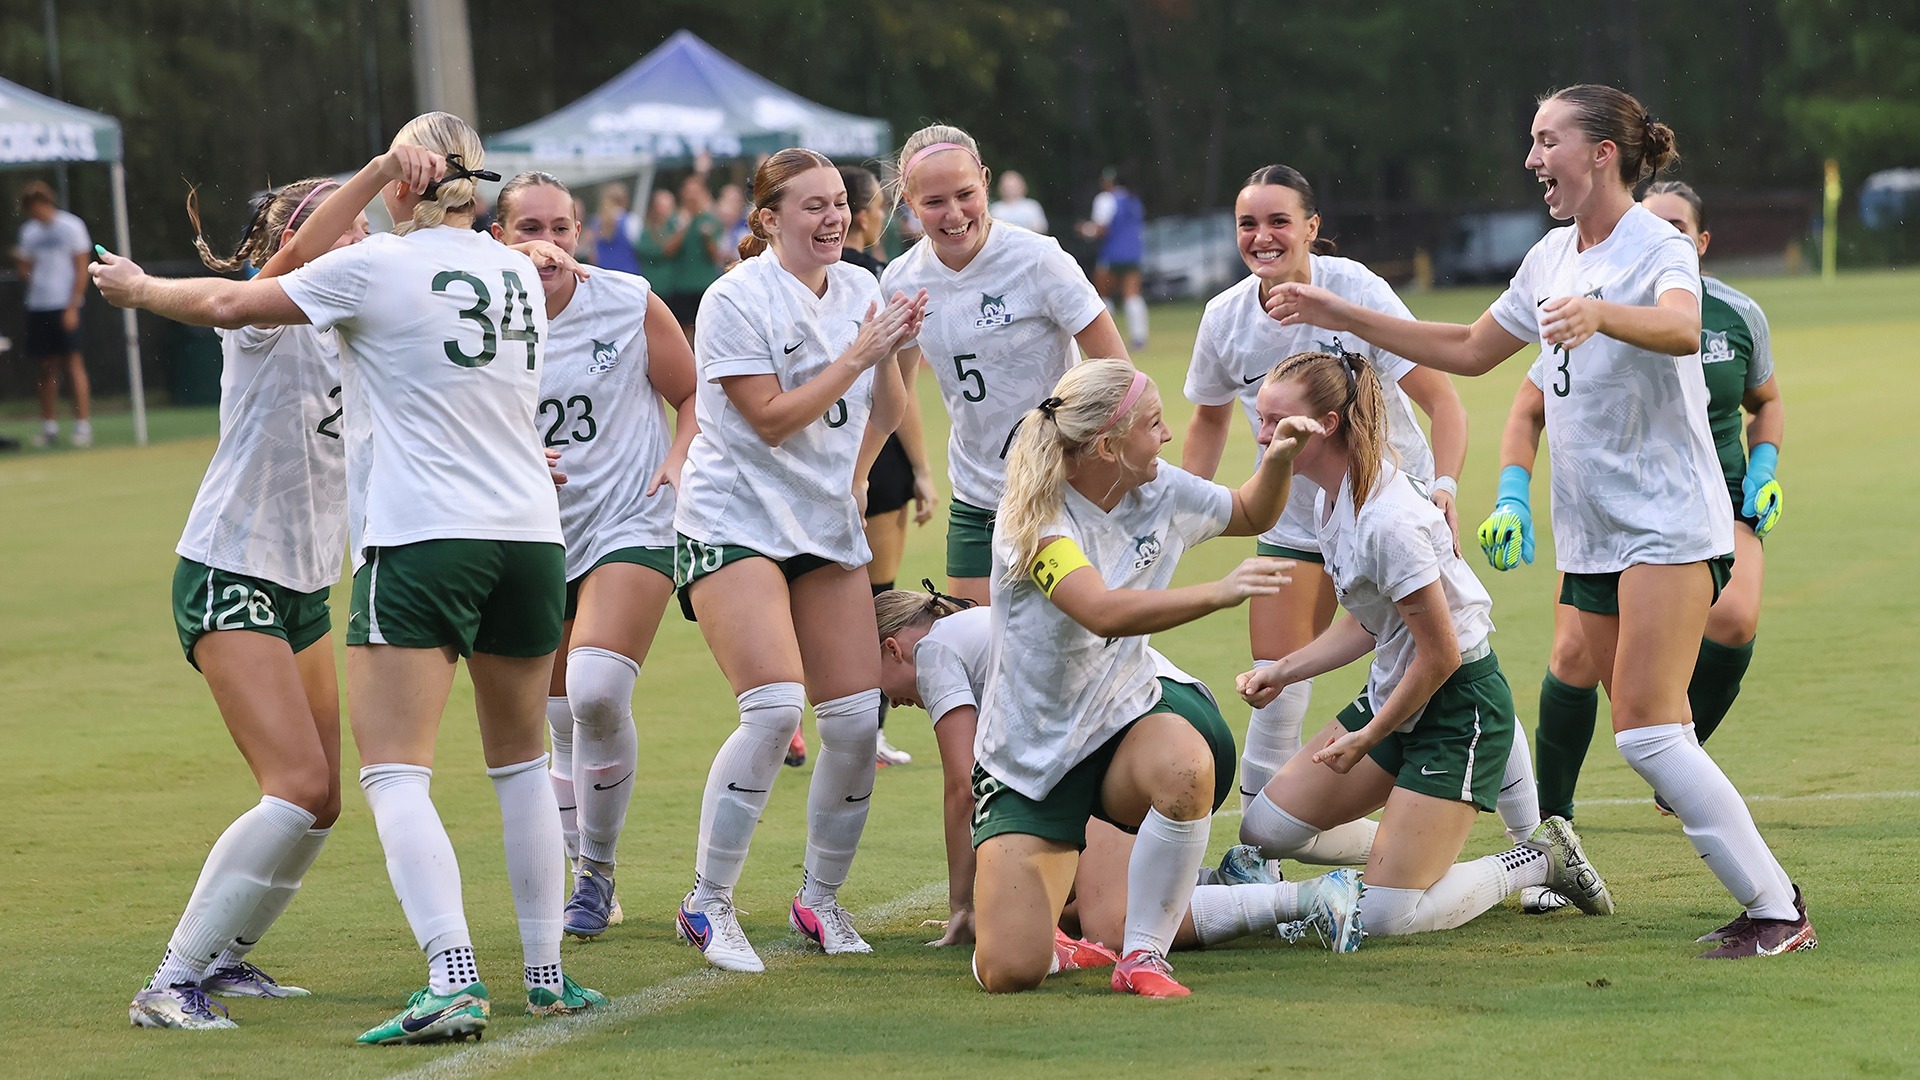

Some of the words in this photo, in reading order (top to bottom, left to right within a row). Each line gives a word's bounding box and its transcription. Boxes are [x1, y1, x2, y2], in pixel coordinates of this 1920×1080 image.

[431, 270, 539, 371] 34
[953, 353, 986, 403] 5
[1552, 342, 1571, 398] 3
[539, 395, 597, 448] 23
[1032, 560, 1055, 593] C
[216, 583, 275, 631] 26
